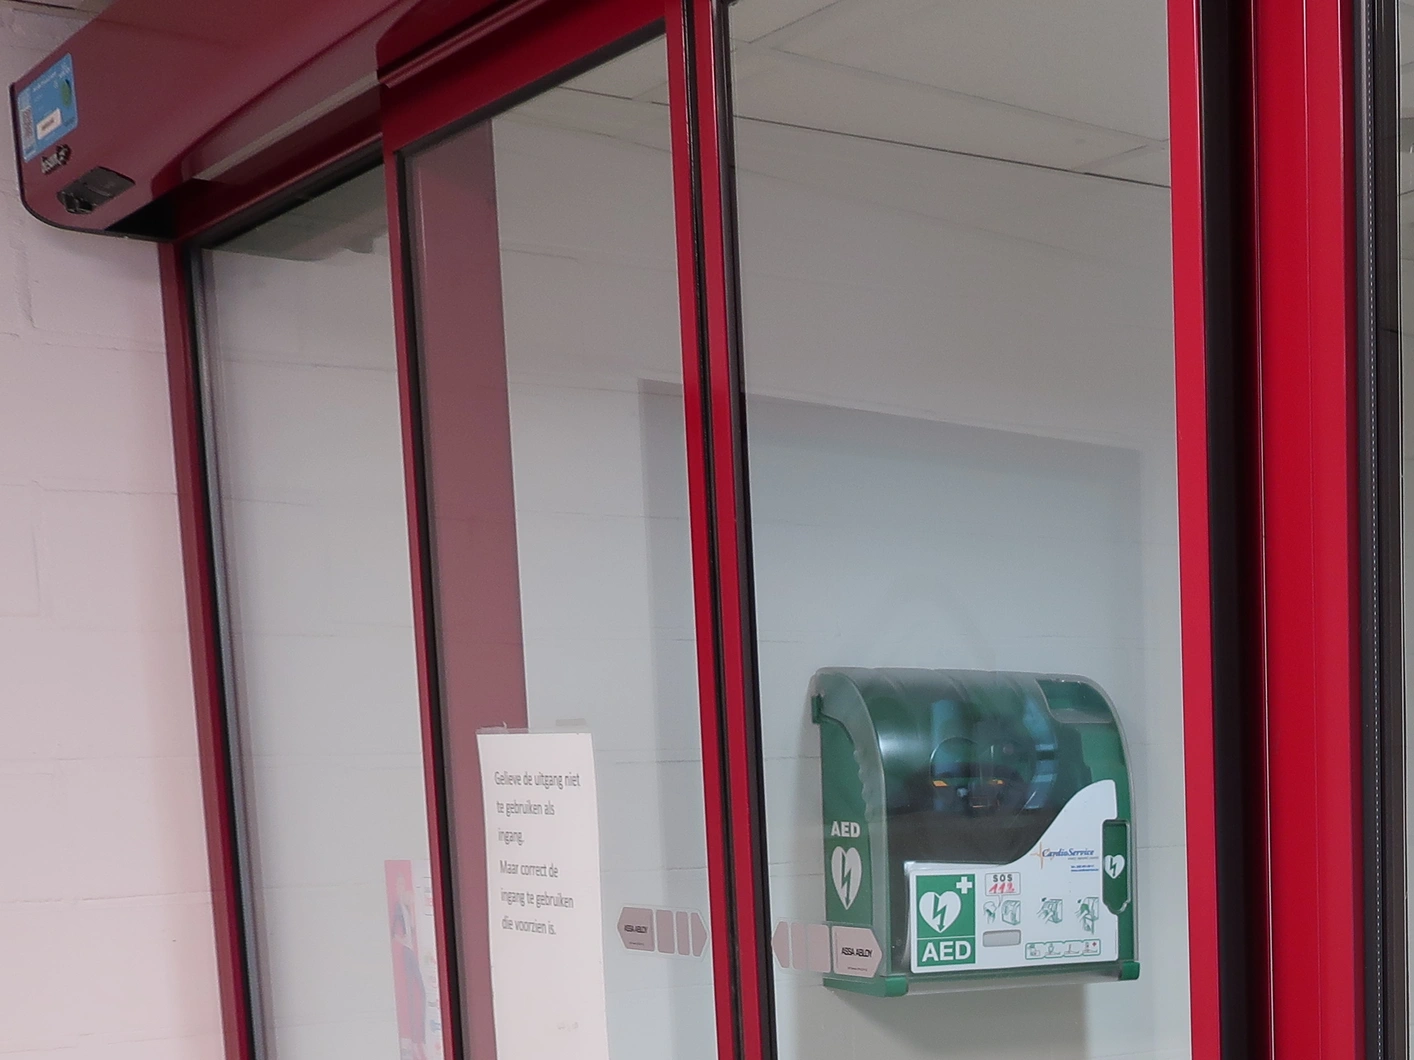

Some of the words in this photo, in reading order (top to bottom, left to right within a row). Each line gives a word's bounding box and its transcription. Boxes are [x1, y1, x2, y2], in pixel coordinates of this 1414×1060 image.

[494, 771, 521, 785] Gelieve
[523, 771, 533, 785] de
[534, 772, 563, 790] uitgang
[565, 772, 581, 786] niet
[496, 800, 504, 813] te
[506, 799, 543, 817] gebruiken
[544, 800, 555, 815] als
[498, 828, 525, 846] ingang.
[831, 820, 860, 838] AED
[1042, 847, 1095, 858] CardioService
[499, 860, 519, 874] Maar
[520, 864, 548, 877] correct
[549, 863, 559, 878] de
[993, 874, 1013, 882] SOS
[988, 882, 1015, 893] 112
[501, 887, 526, 907] ingang
[526, 891, 535, 904] te
[536, 891, 574, 908] gebruiken
[502, 915, 513, 930] die
[514, 919, 547, 934] voorzien
[548, 921, 557, 935] is.
[921, 940, 972, 962] AED
